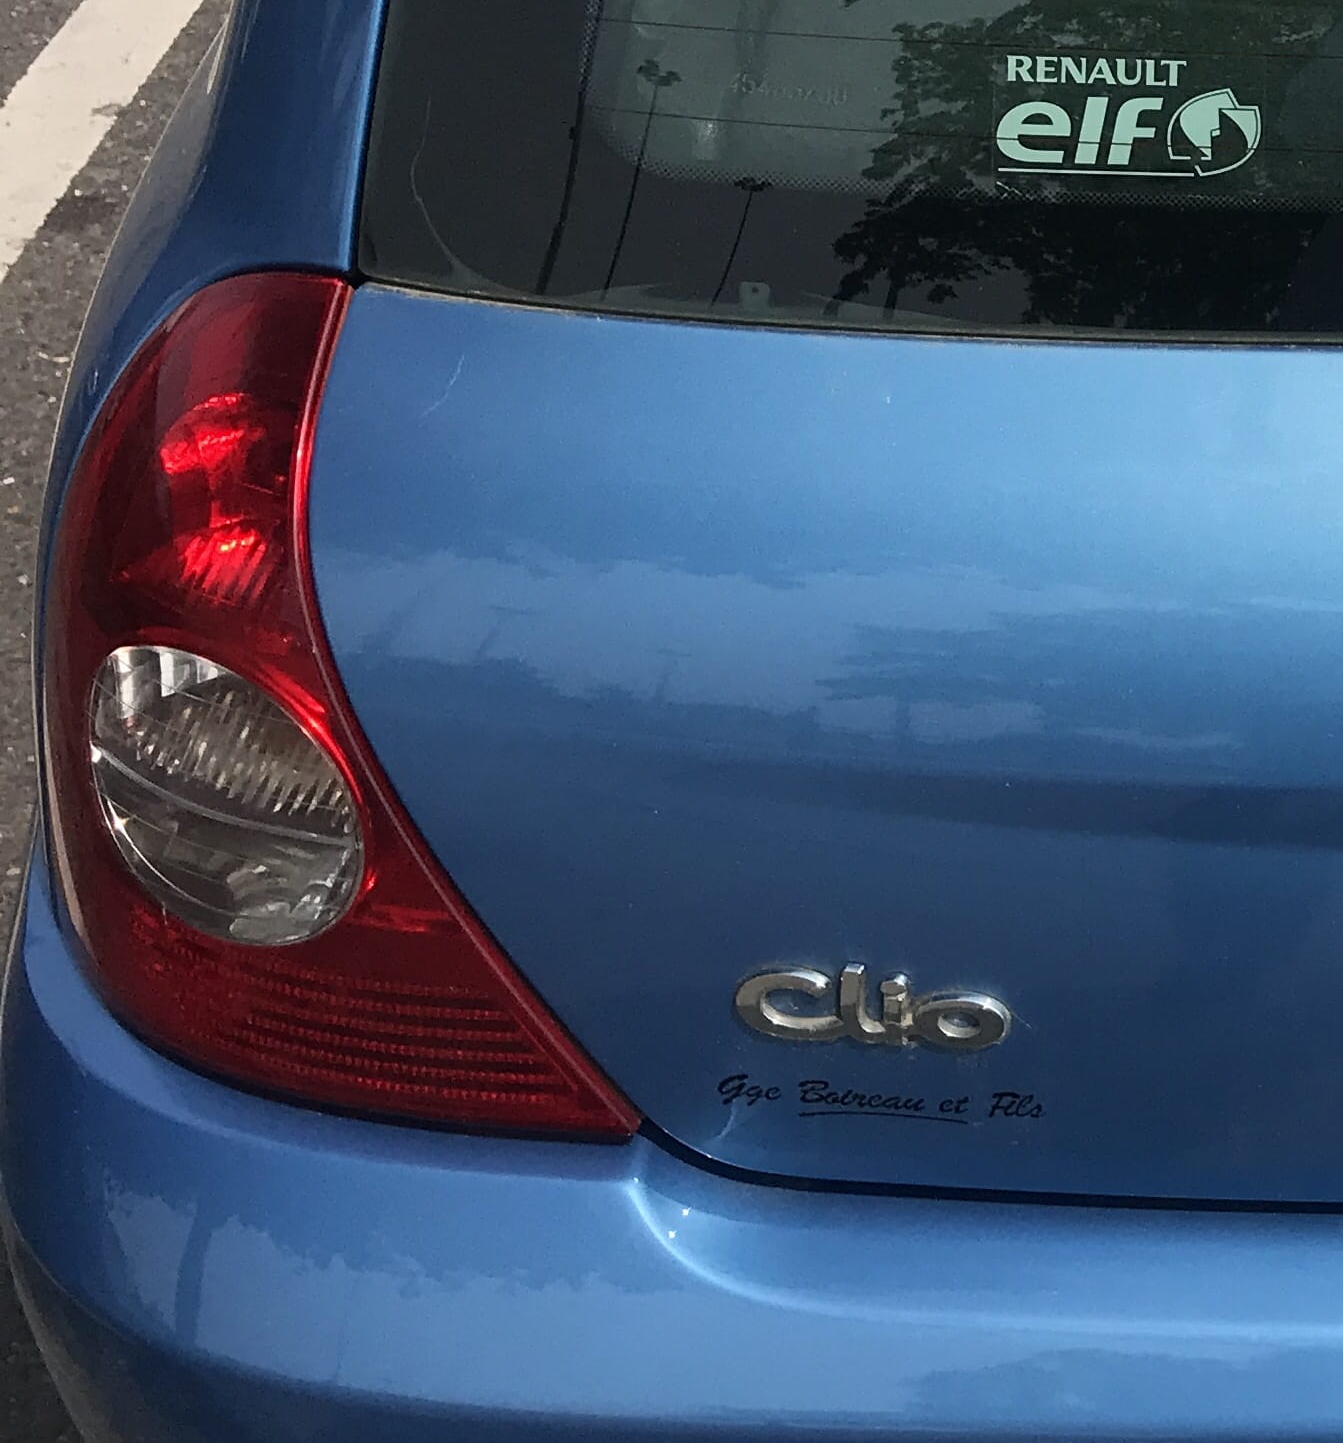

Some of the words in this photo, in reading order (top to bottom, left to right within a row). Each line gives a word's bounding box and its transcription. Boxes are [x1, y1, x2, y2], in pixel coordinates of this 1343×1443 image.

[1006, 55, 1187, 86] RENAULT
[997, 97, 1164, 165] elf
[734, 961, 1013, 1049] Clio
[938, 1096, 970, 1114] et
[988, 1092, 1047, 1119] Fils
